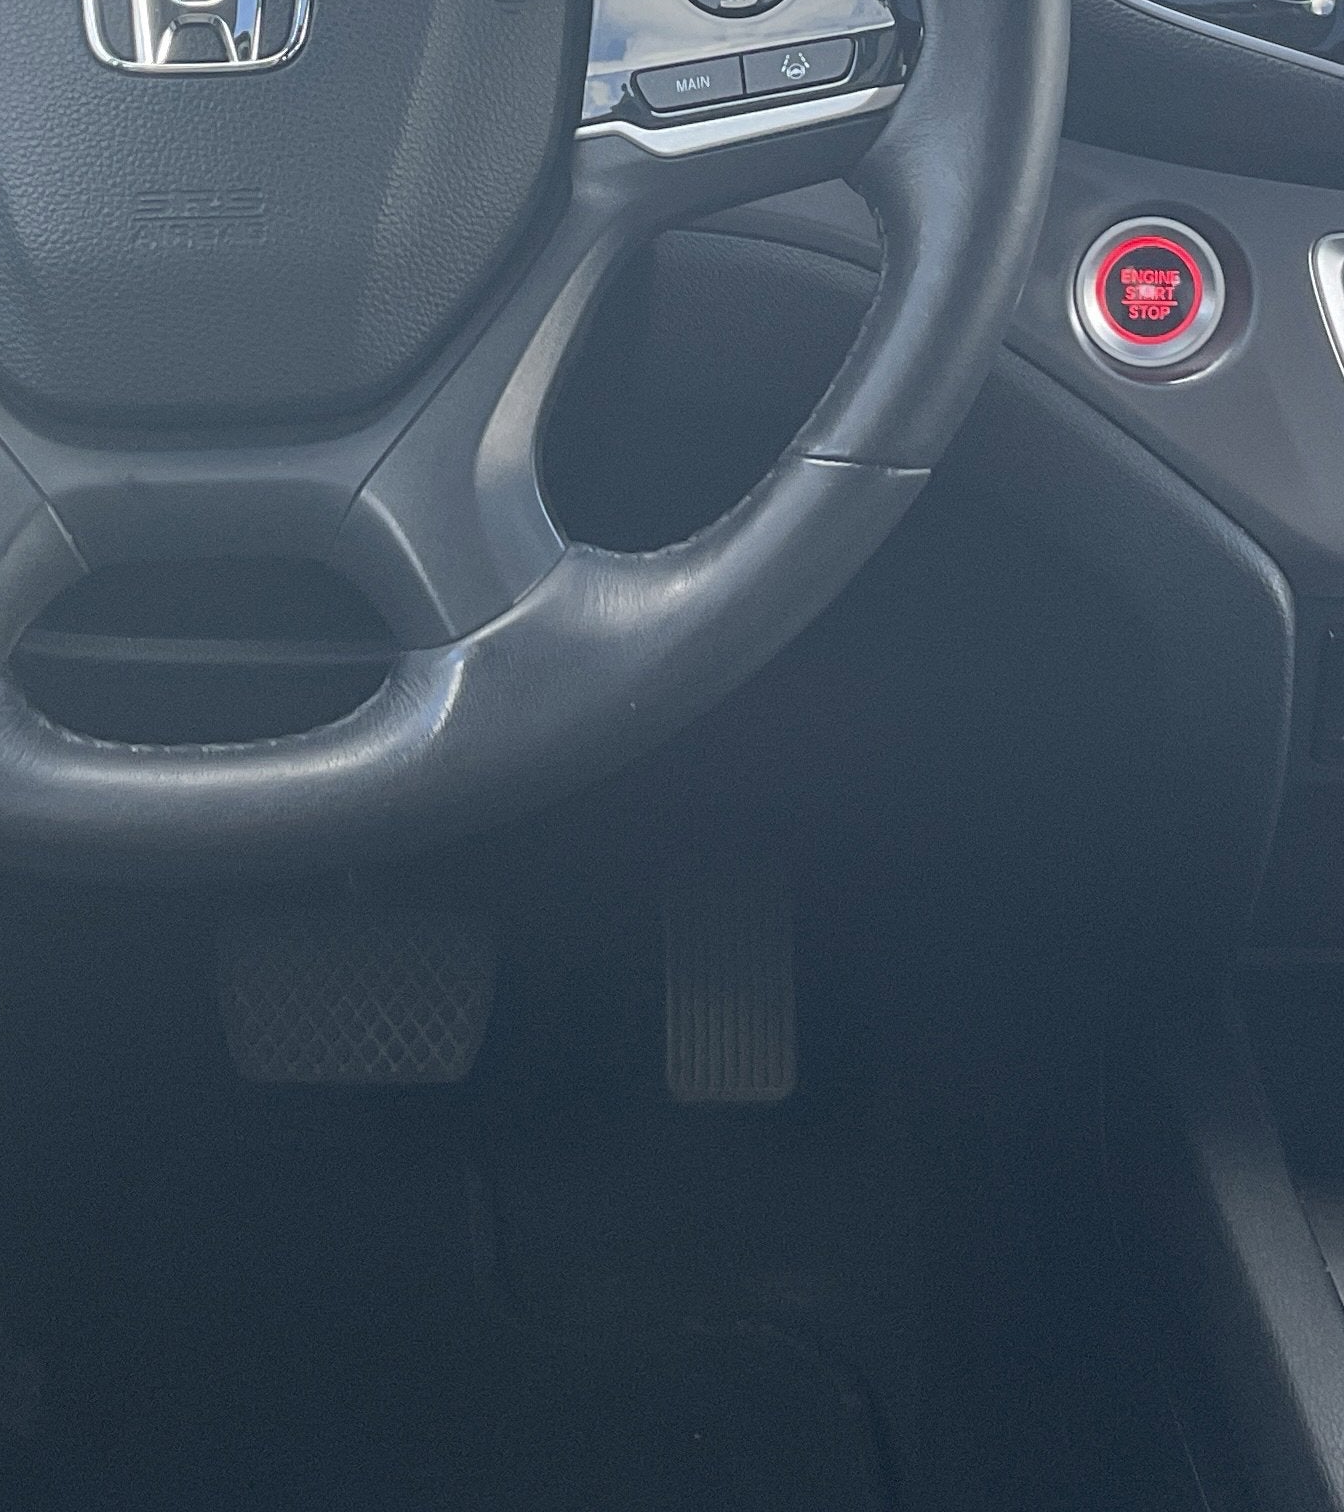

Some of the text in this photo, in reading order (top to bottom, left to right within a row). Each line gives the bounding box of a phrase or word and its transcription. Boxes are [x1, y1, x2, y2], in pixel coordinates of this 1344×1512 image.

[676, 76, 711, 92] MAIN
[1120, 268, 1181, 285] ENGINE
[1125, 286, 1175, 300] START
[1128, 306, 1171, 320] STOP
